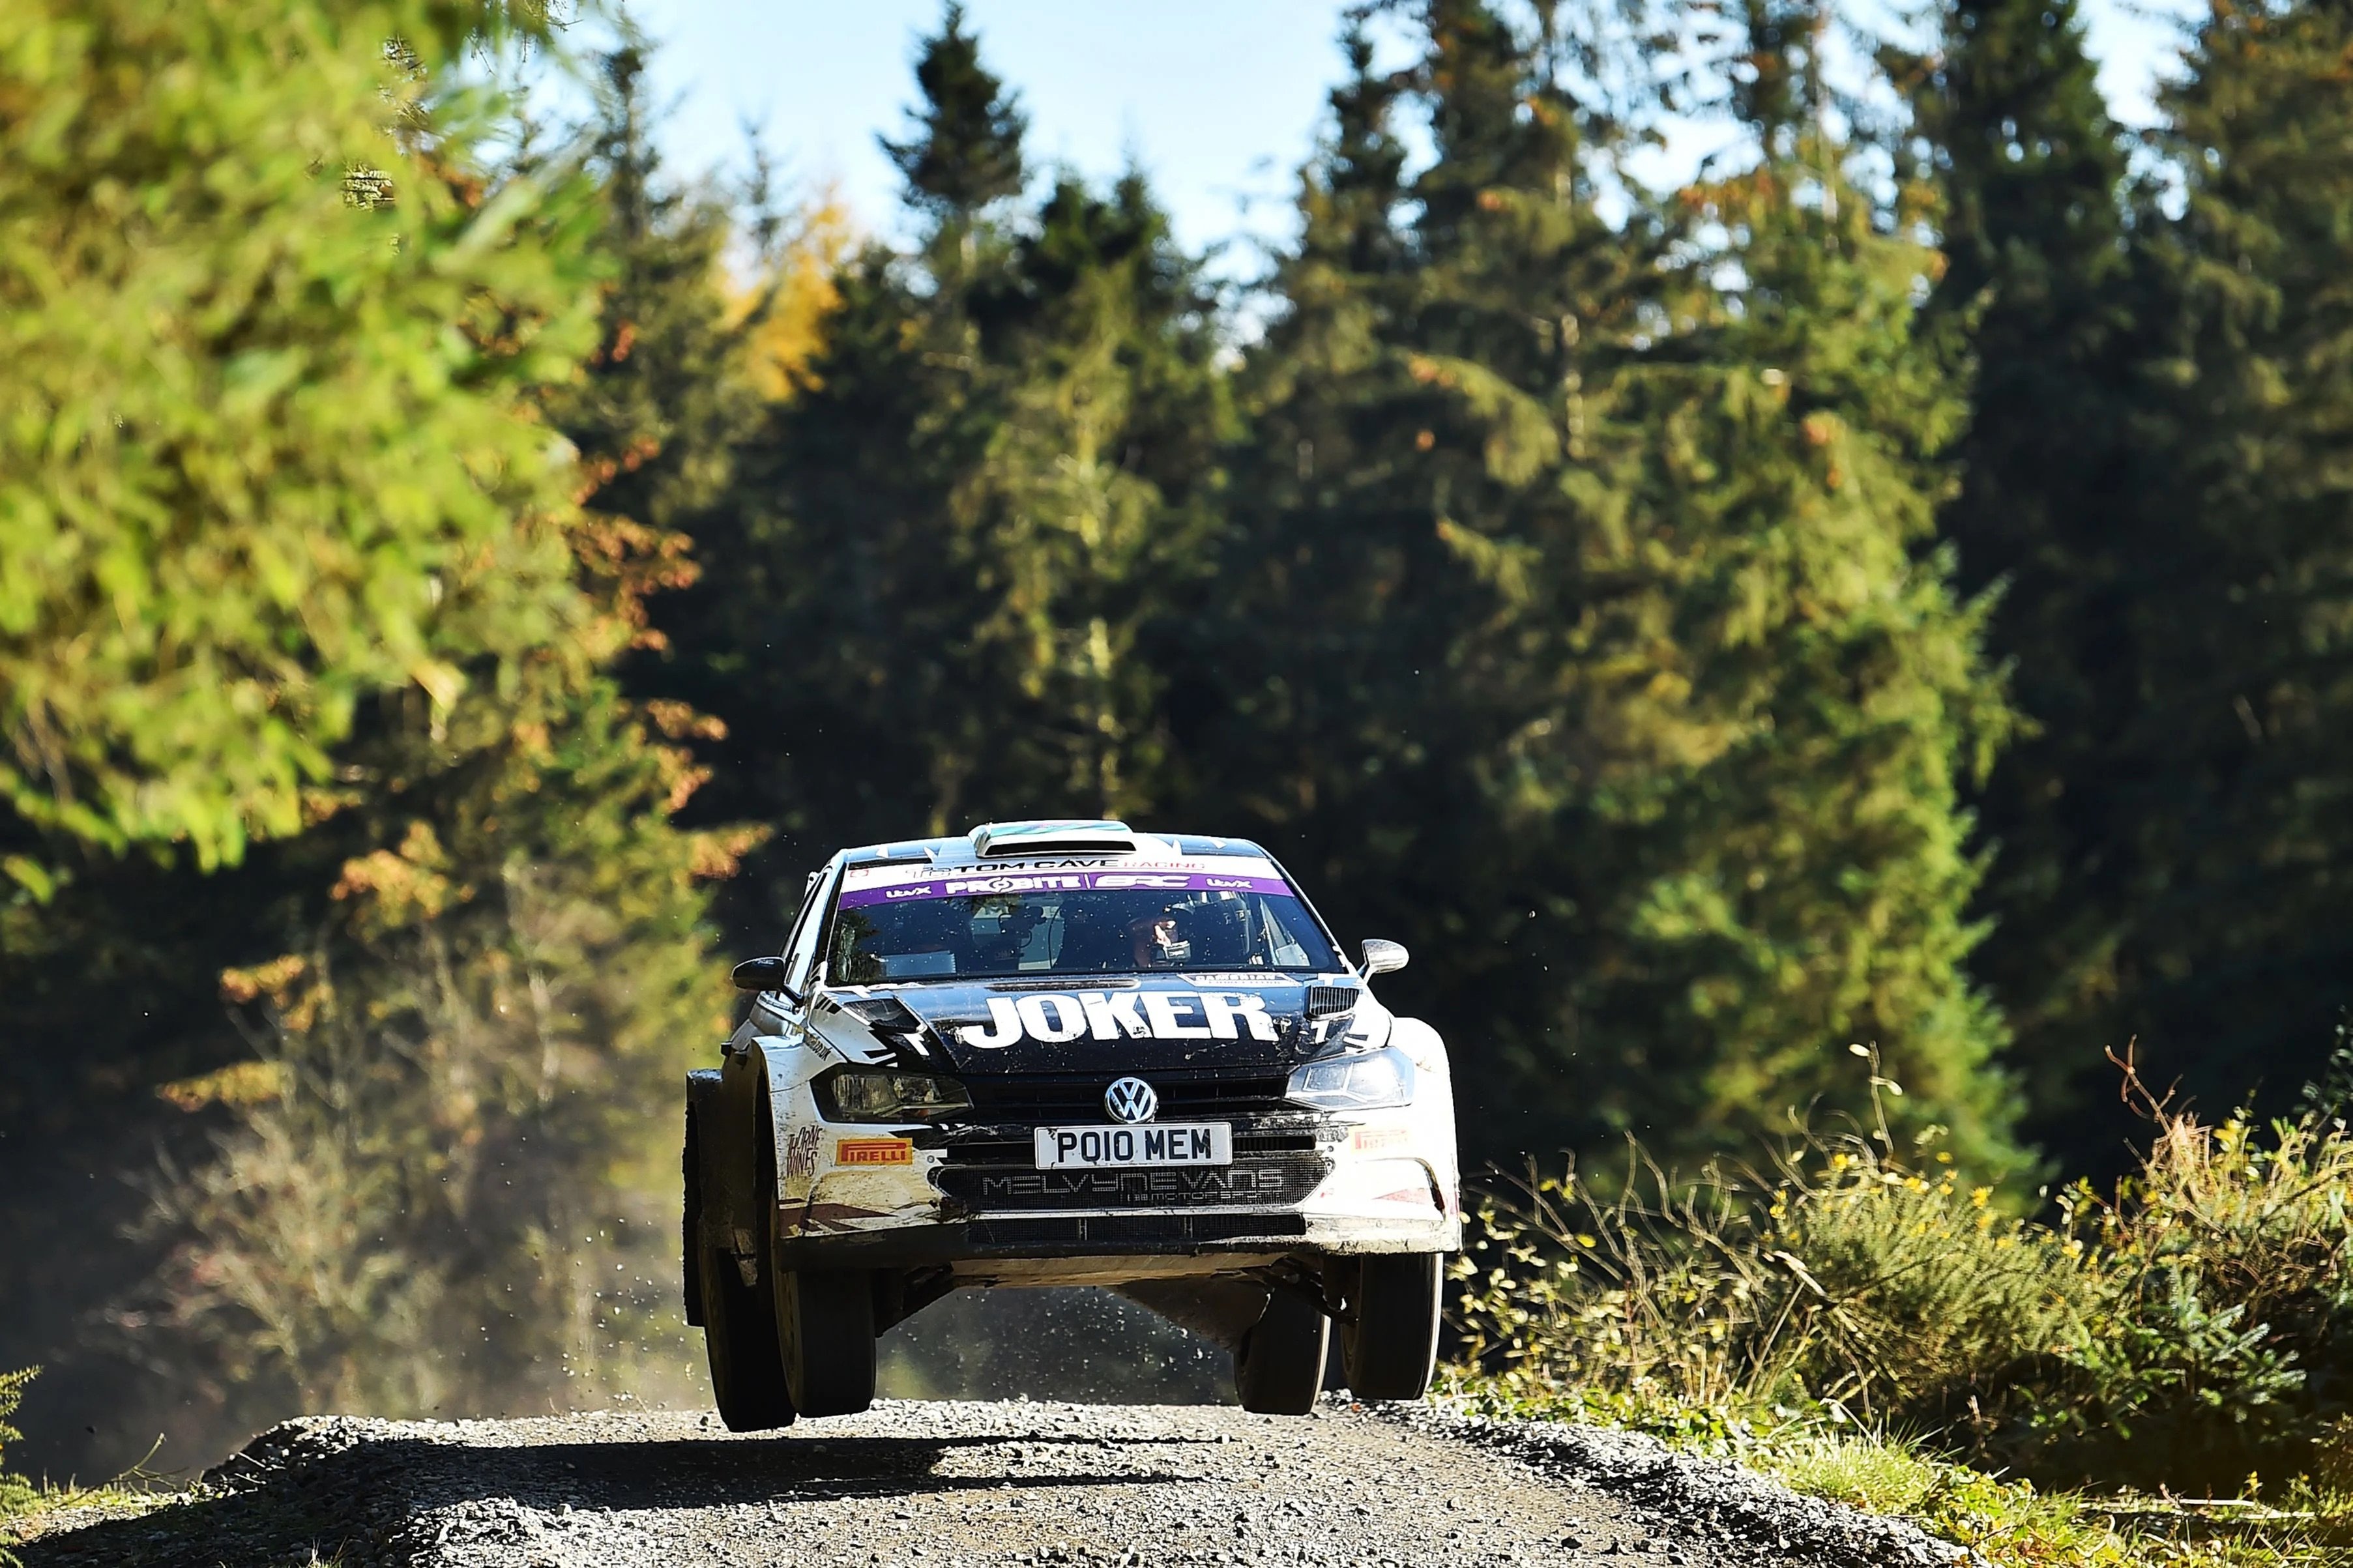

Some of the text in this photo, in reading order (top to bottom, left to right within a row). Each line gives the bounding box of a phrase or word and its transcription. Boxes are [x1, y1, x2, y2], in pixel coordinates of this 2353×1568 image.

[954, 860, 1205, 873] TOM CAVE RACING
[945, 876, 1081, 894] PROBITE
[961, 991, 1279, 1049] JOKER
[788, 1125, 823, 1157] THORNE
[841, 1142, 907, 1162] PIRELLI
[1058, 1128, 1211, 1163] PO10 MEM
[786, 1147, 818, 1178] WINES
